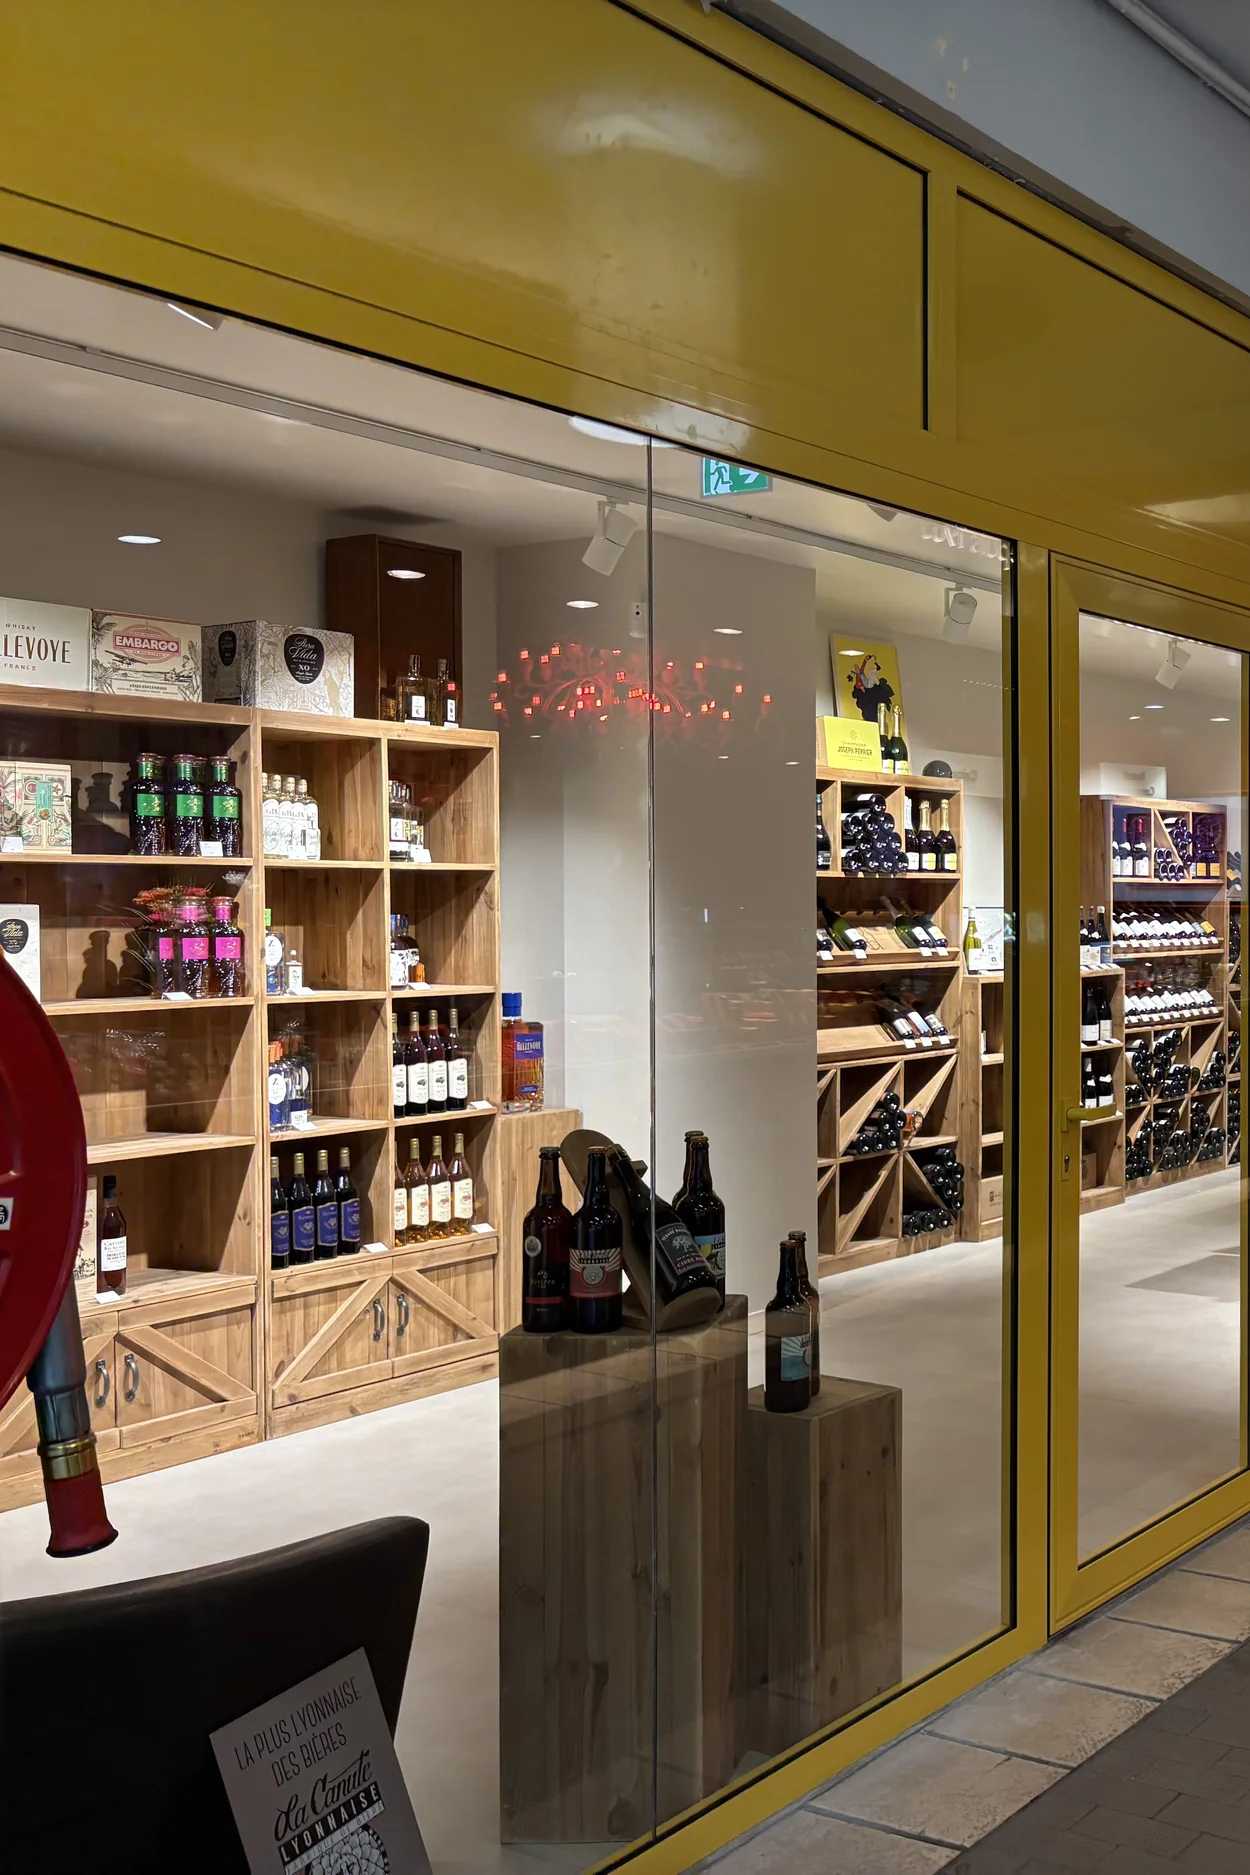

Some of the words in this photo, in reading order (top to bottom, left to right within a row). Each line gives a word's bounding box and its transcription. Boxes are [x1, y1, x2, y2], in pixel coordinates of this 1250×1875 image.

[5, 622, 37, 631] WHISKY
[0, 633, 72, 664] LEVOYE
[115, 635, 179, 652] EMBARGO
[288, 646, 319, 661] Vida
[3, 662, 37, 671] FRANCE
[298, 664, 311, 672] XO
[233, 1742, 256, 1771] LA
[252, 1719, 292, 1760] PLUS
[288, 1675, 363, 1738] LYONNAISE
[270, 1750, 302, 1788] DES
[299, 1721, 348, 1769] BIÈRES
[273, 1793, 309, 1842] La
[310, 1748, 374, 1817] Canute
[280, 1784, 380, 1863] LYONNAISE
